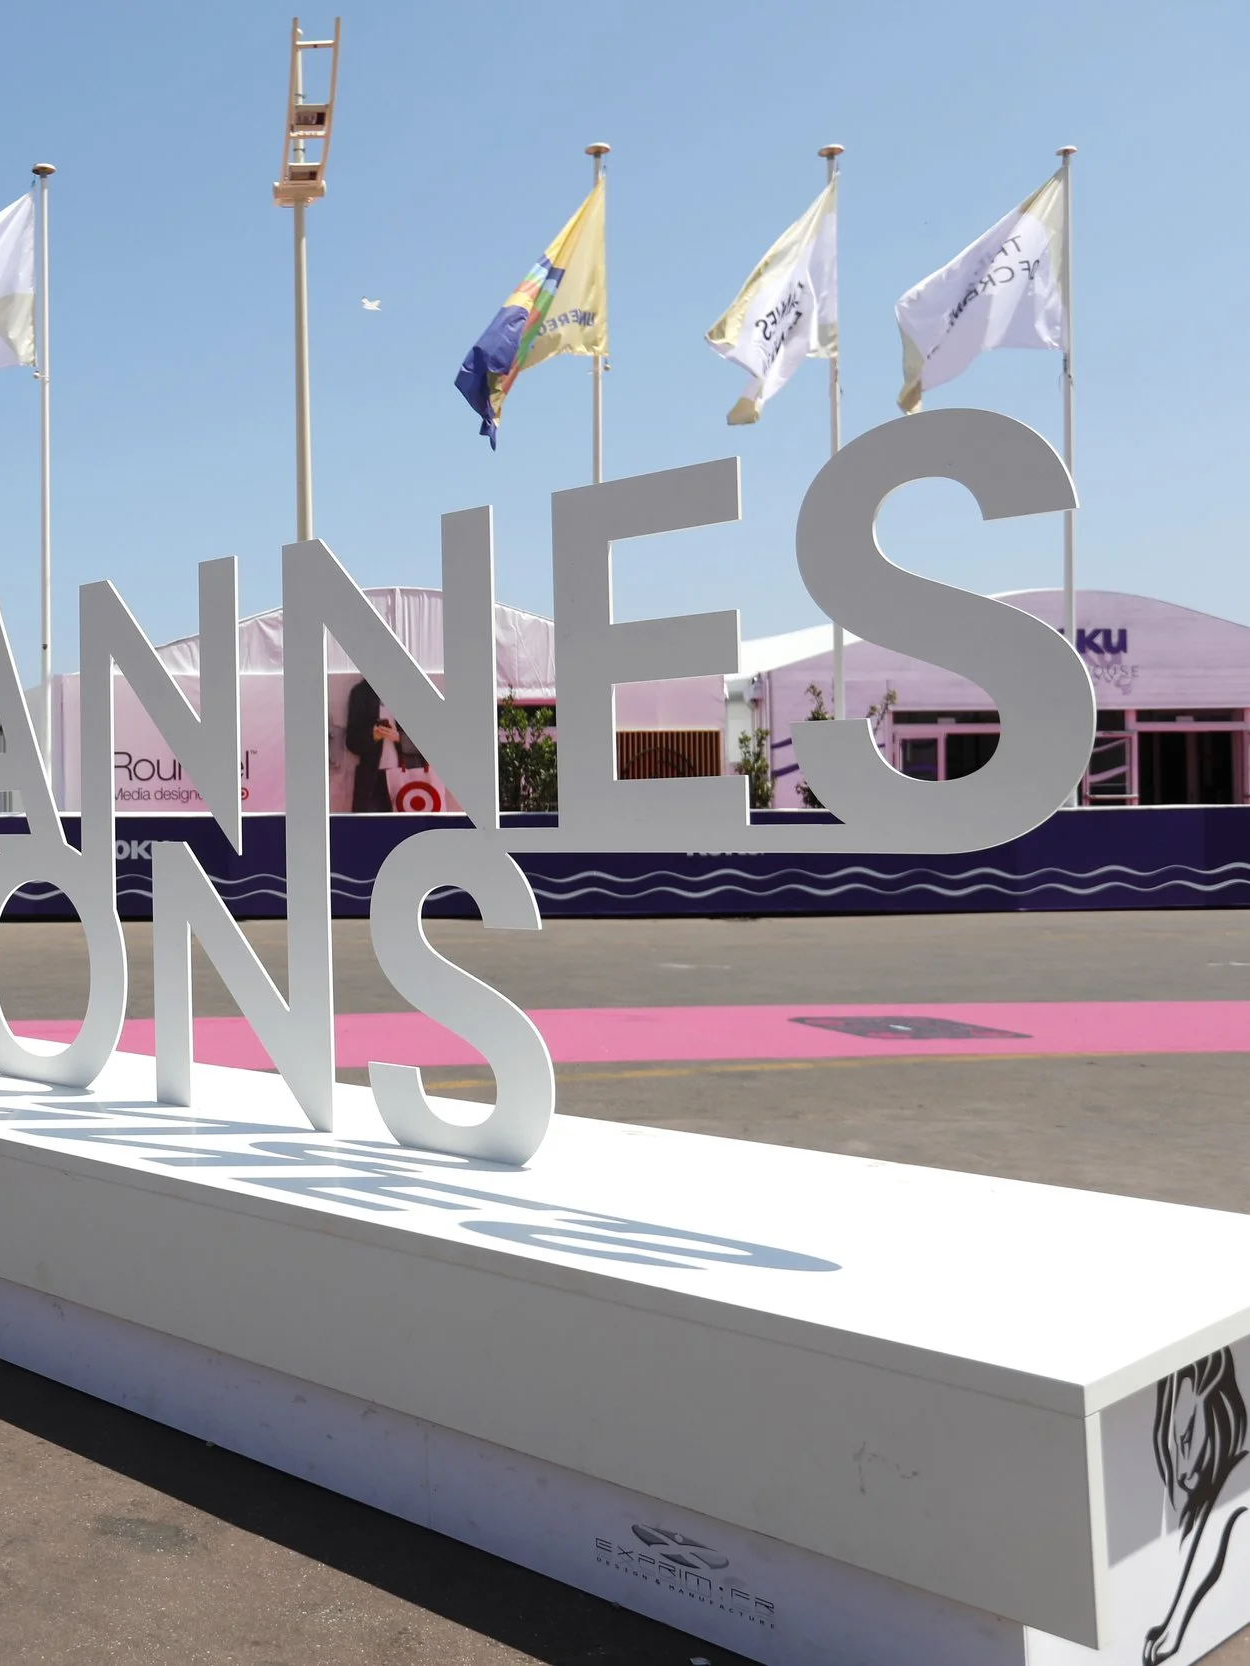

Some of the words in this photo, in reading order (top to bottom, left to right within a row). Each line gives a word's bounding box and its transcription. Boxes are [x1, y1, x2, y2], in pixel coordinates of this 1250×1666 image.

[1058, 628, 1127, 654] ku
[114, 751, 250, 781] Roul
[154, 787, 203, 803] design
[596, 1556, 648, 1581] DESIGN
[668, 1584, 775, 1630] MANUFACTURE
